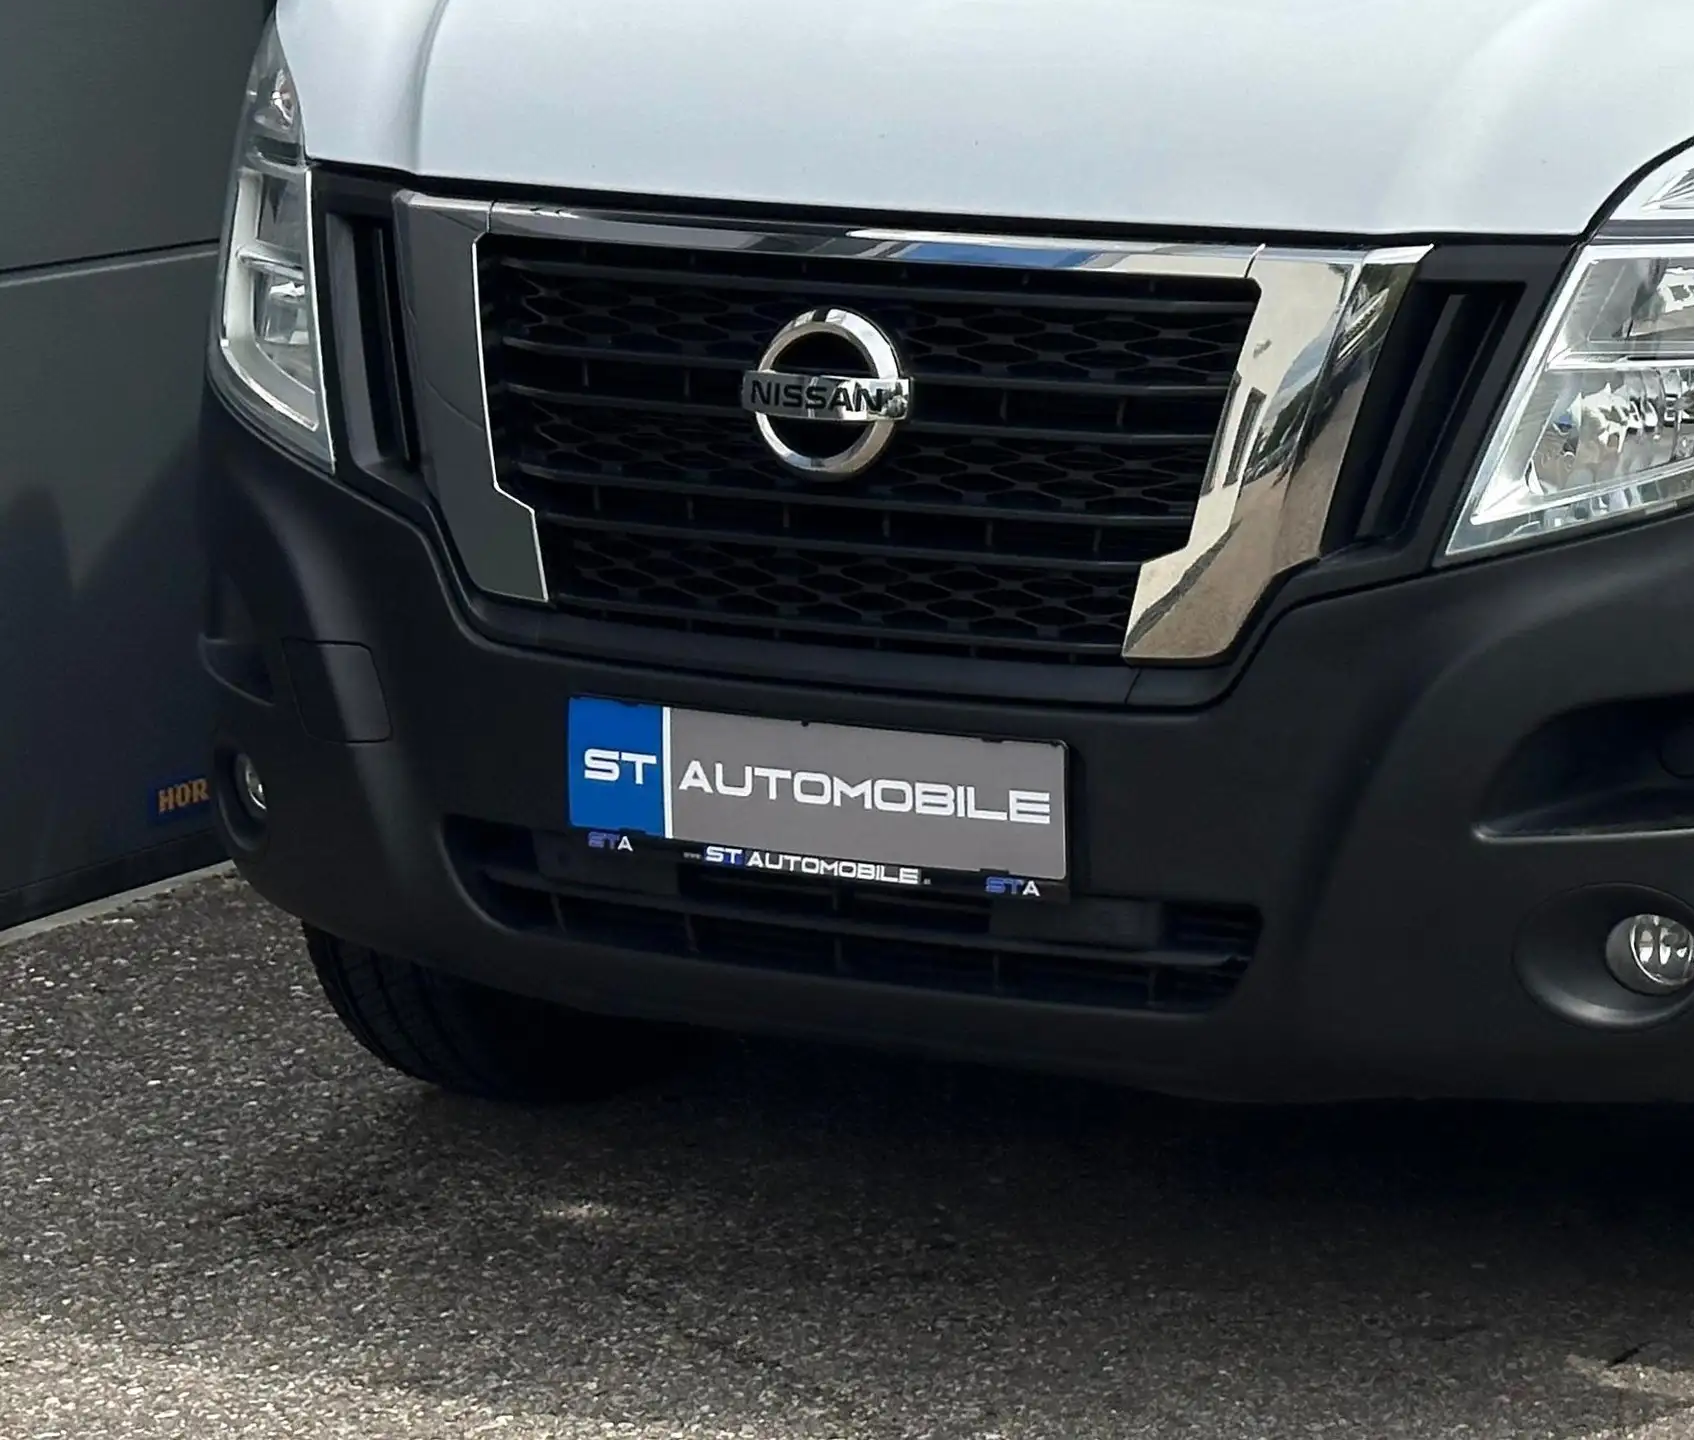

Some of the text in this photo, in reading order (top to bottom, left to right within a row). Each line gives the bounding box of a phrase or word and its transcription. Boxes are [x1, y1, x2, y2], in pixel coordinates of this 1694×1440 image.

[750, 380, 882, 412] NISSAN
[583, 748, 1051, 824] ST AUTOMOBILE
[705, 846, 920, 884] ST AUTOMOBILE
